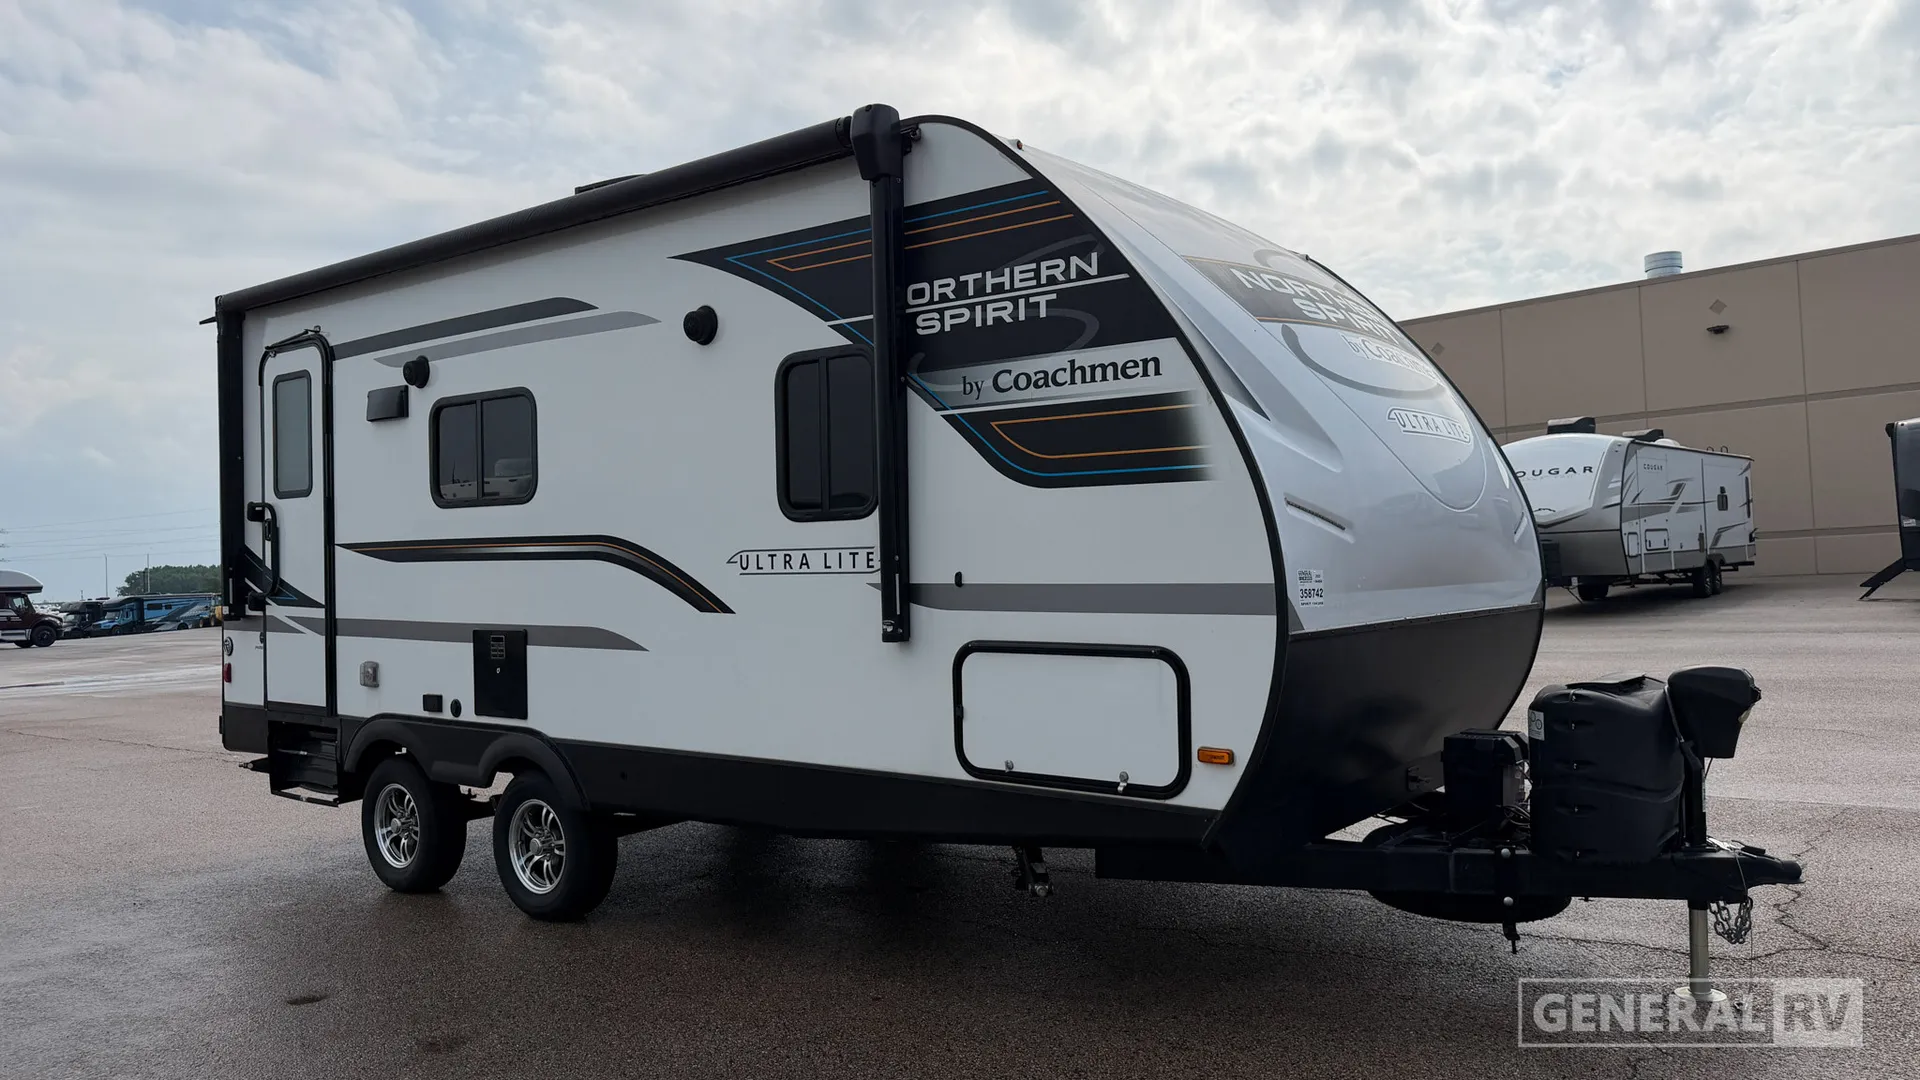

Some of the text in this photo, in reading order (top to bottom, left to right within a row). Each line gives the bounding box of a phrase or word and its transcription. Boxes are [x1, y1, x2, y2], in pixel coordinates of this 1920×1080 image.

[906, 251, 1100, 306] ORTHERN
[915, 293, 1058, 336] SPIRIT
[1292, 297, 1400, 345] SPIRIT
[961, 354, 1163, 401] by Coachmen
[1393, 411, 1441, 433] ULTRA
[1515, 465, 1594, 479] OUGAR
[739, 551, 875, 571] ULTRA LITE
[1299, 588, 1324, 599] 358742
